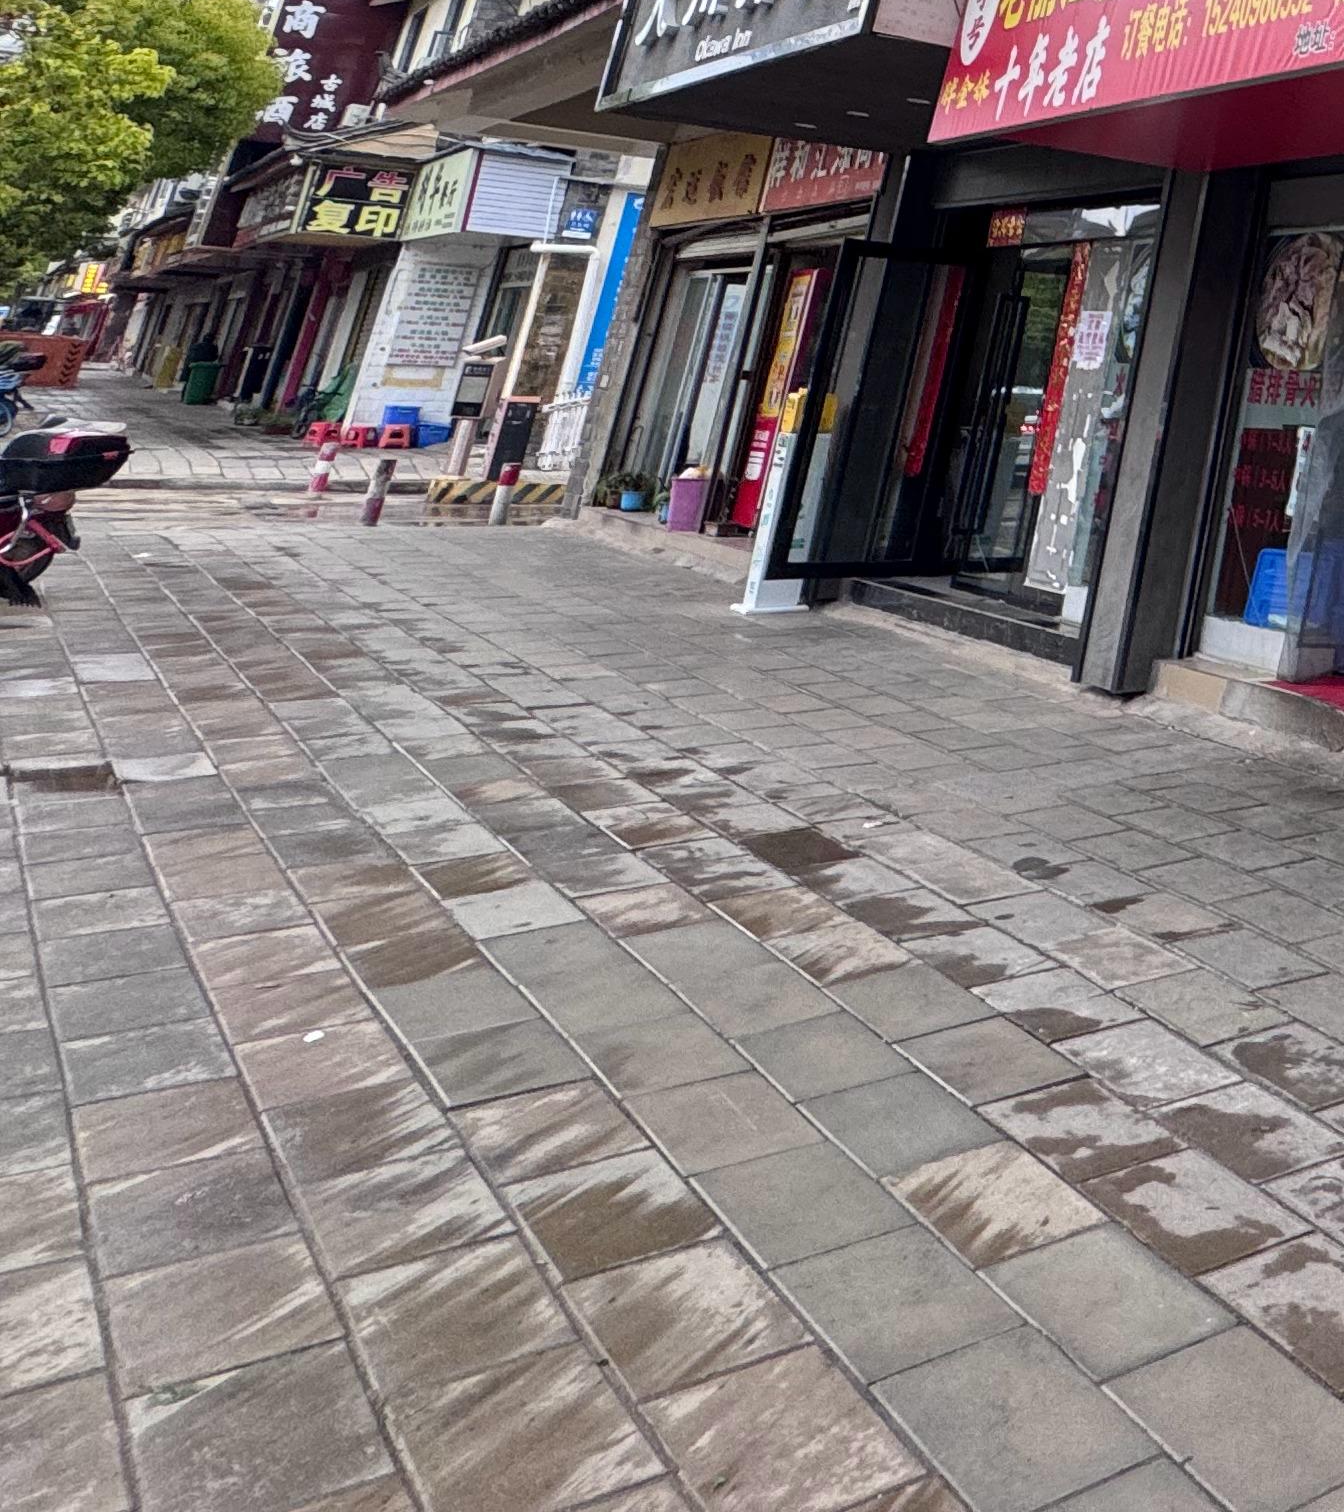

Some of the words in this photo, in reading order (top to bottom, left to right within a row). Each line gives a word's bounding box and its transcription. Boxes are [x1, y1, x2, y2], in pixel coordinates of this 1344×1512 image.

[993, 16, 1112, 122] 十年老店
[940, 68, 991, 115] 胖金妹
[315, 166, 410, 203] 广告
[306, 200, 401, 237] 复印
